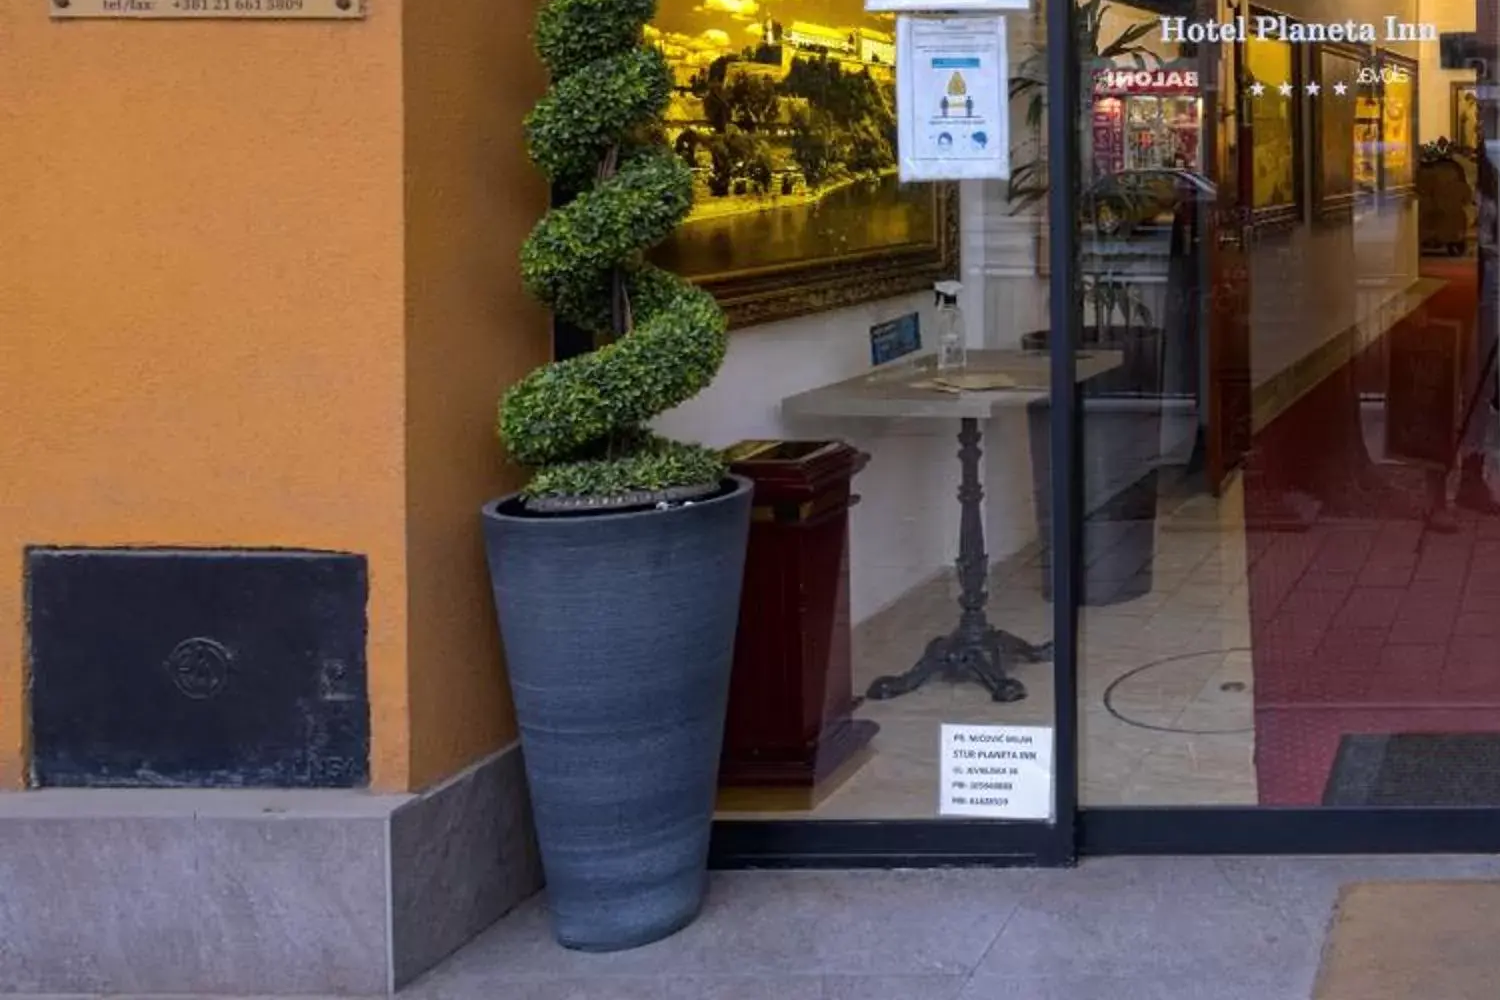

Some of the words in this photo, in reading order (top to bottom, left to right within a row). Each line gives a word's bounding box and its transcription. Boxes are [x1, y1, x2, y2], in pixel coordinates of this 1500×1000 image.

[1160, 15, 1247, 42] Hotel
[1256, 15, 1376, 42] Planeta
[1386, 16, 1438, 42] Inn
